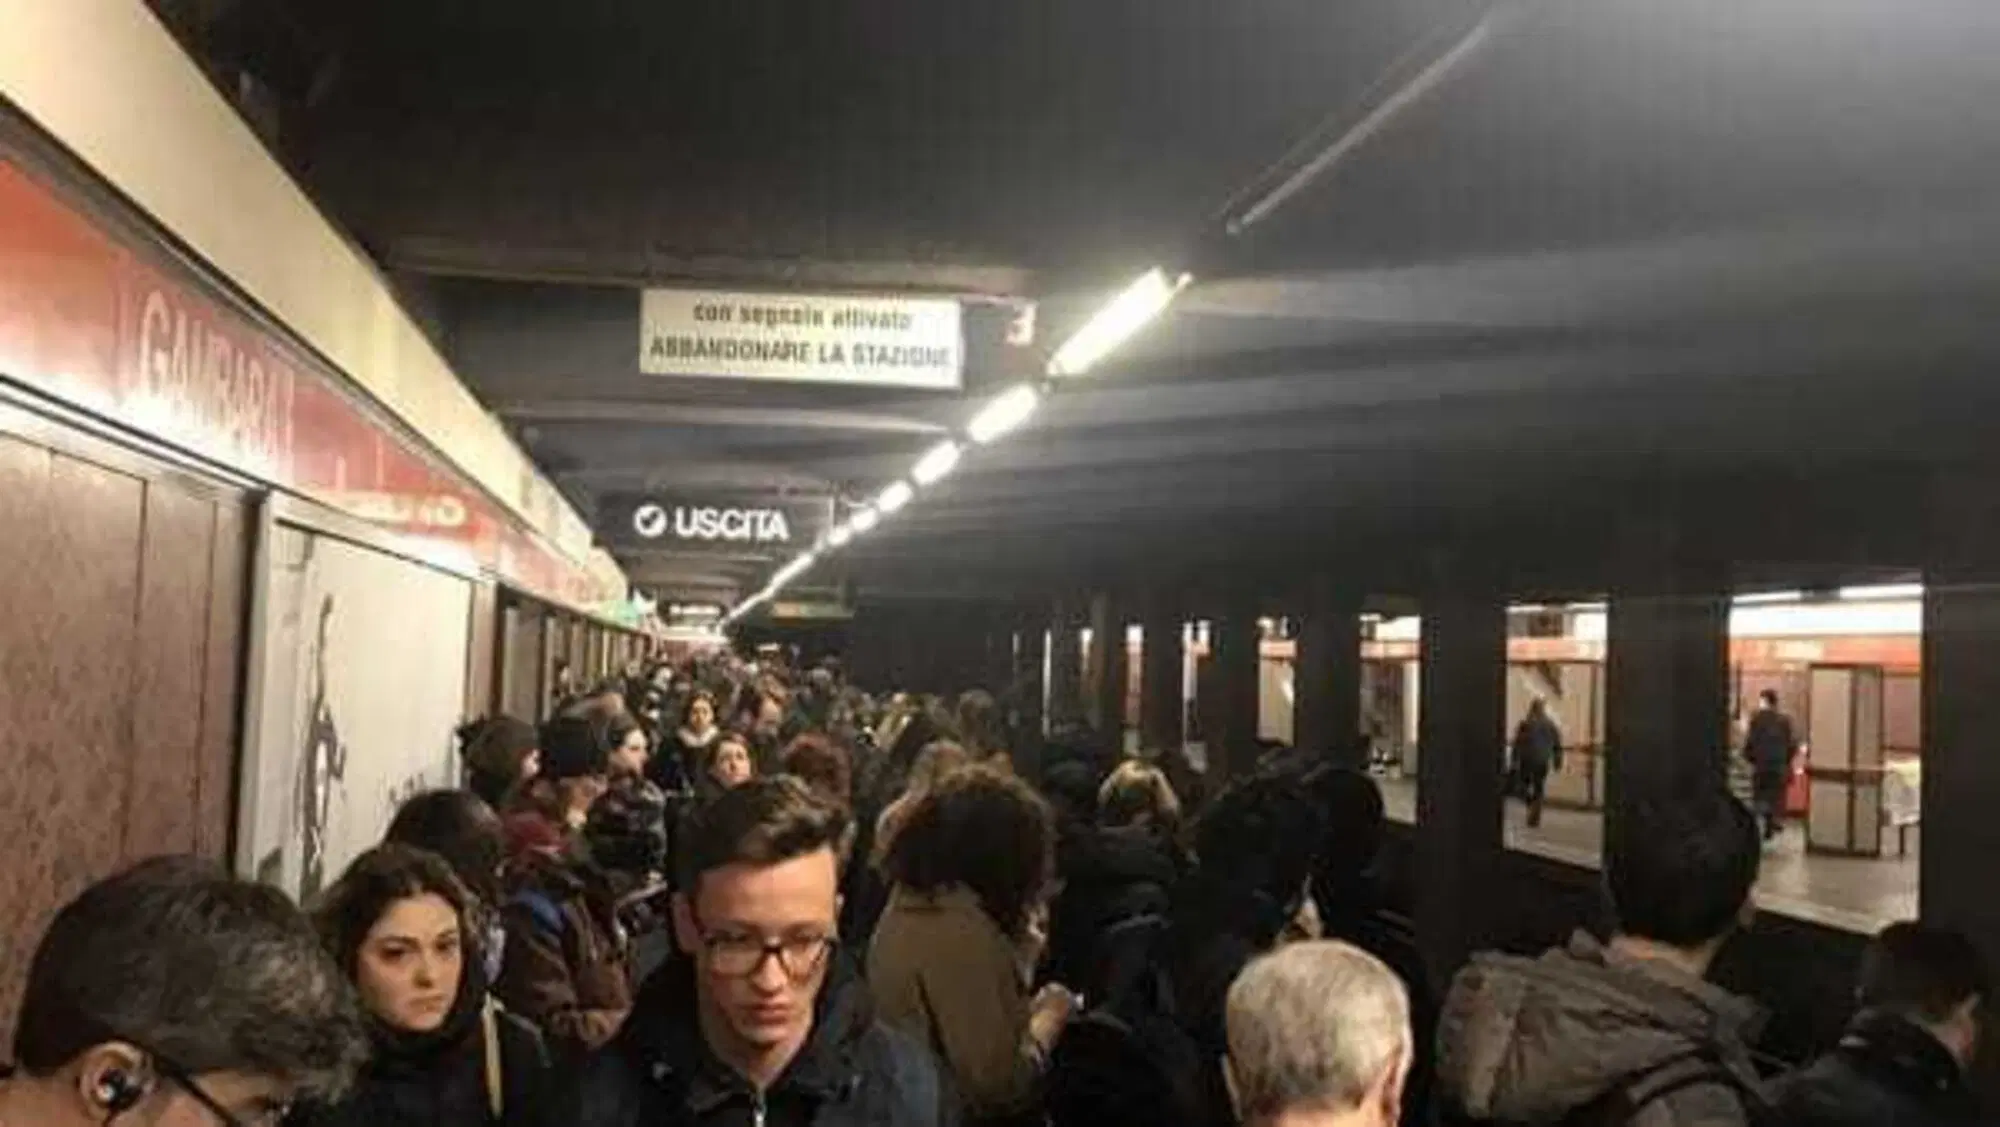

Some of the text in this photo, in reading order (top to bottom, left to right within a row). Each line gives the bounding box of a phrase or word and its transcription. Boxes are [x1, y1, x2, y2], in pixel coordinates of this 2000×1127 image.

[692, 304, 732, 322] con
[650, 333, 811, 363] ABBANDONARE
[819, 341, 846, 364] LA
[674, 505, 790, 541] USCITA
